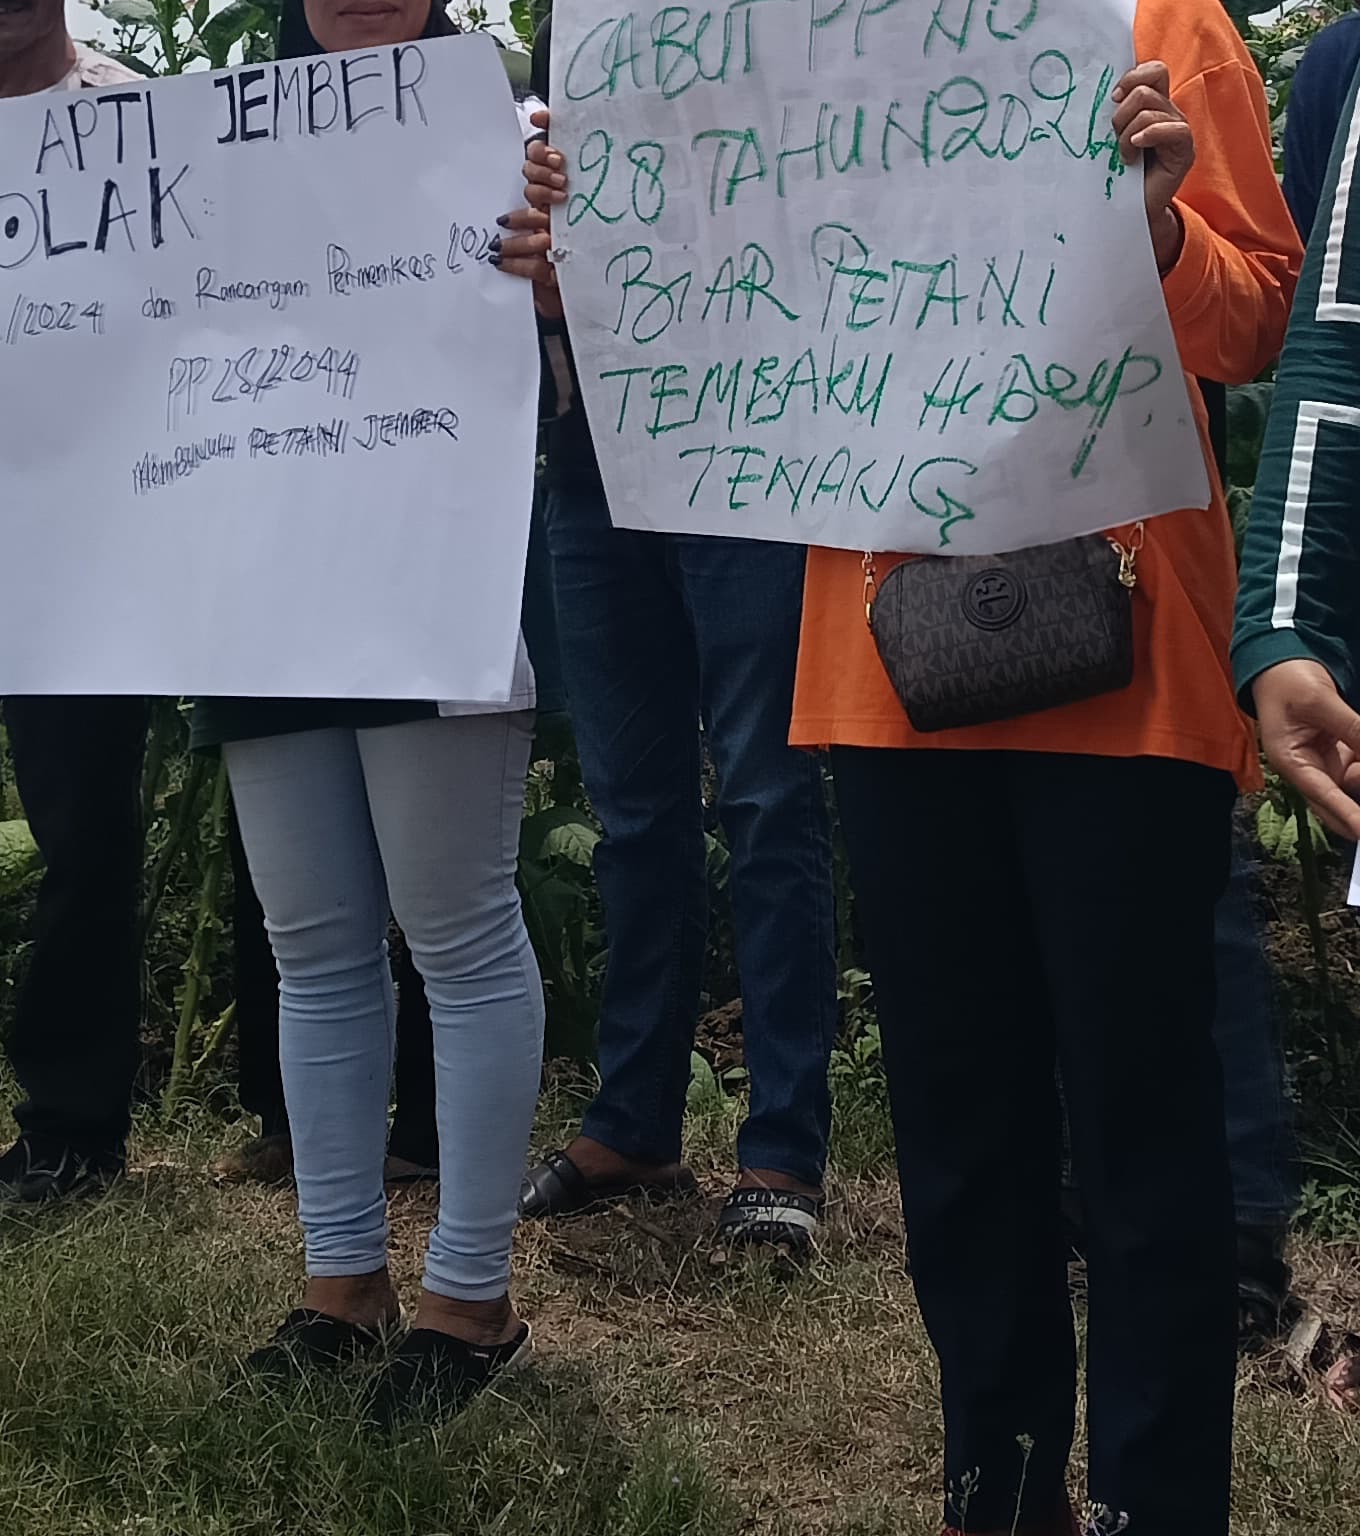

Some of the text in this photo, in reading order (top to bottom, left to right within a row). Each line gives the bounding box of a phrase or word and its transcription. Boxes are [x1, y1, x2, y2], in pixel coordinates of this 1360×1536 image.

[36, 45, 429, 174] APTI JEMBER
[567, 129, 666, 226] 28
[691, 89, 937, 216] TAHUN
[446, 222, 502, 271] 202
[606, 242, 800, 344] BIAR
[167, 357, 210, 432] PP
[678, 444, 977, 547] TENANG
